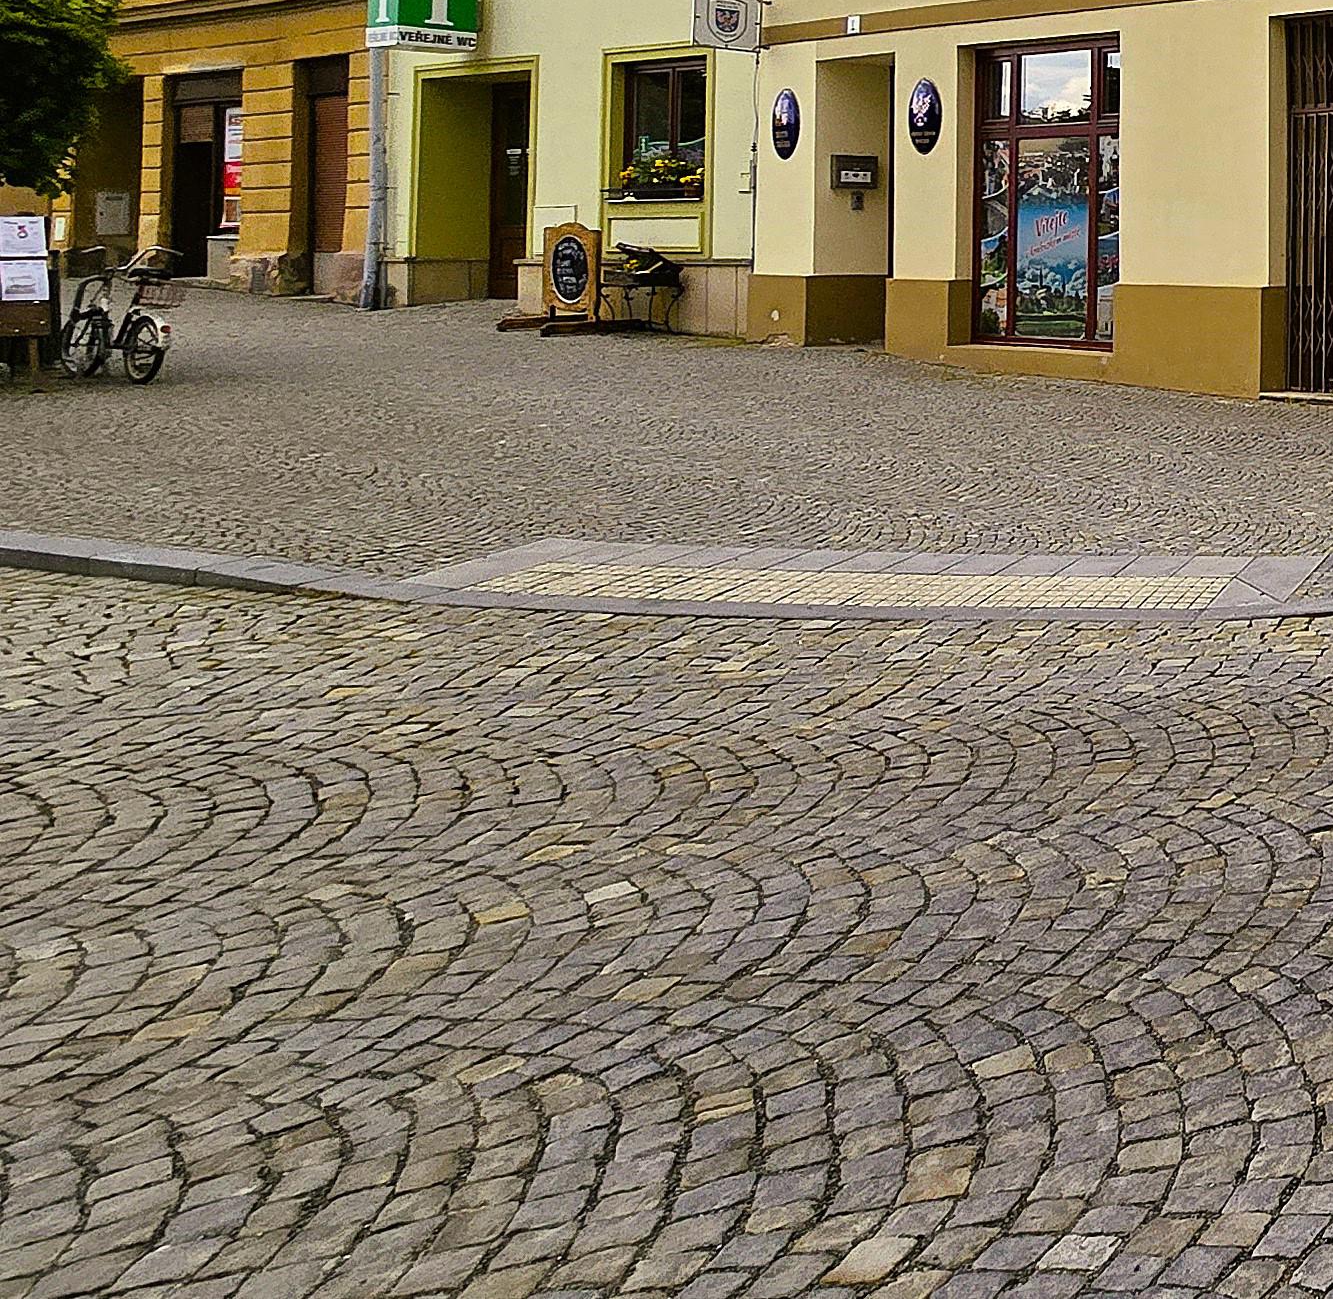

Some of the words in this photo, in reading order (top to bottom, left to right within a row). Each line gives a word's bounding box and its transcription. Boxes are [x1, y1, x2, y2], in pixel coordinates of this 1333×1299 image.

[399, 30, 453, 46] VEŘEJNÉ
[456, 36, 477, 48] WC
[1035, 210, 1069, 237] Vítejte
